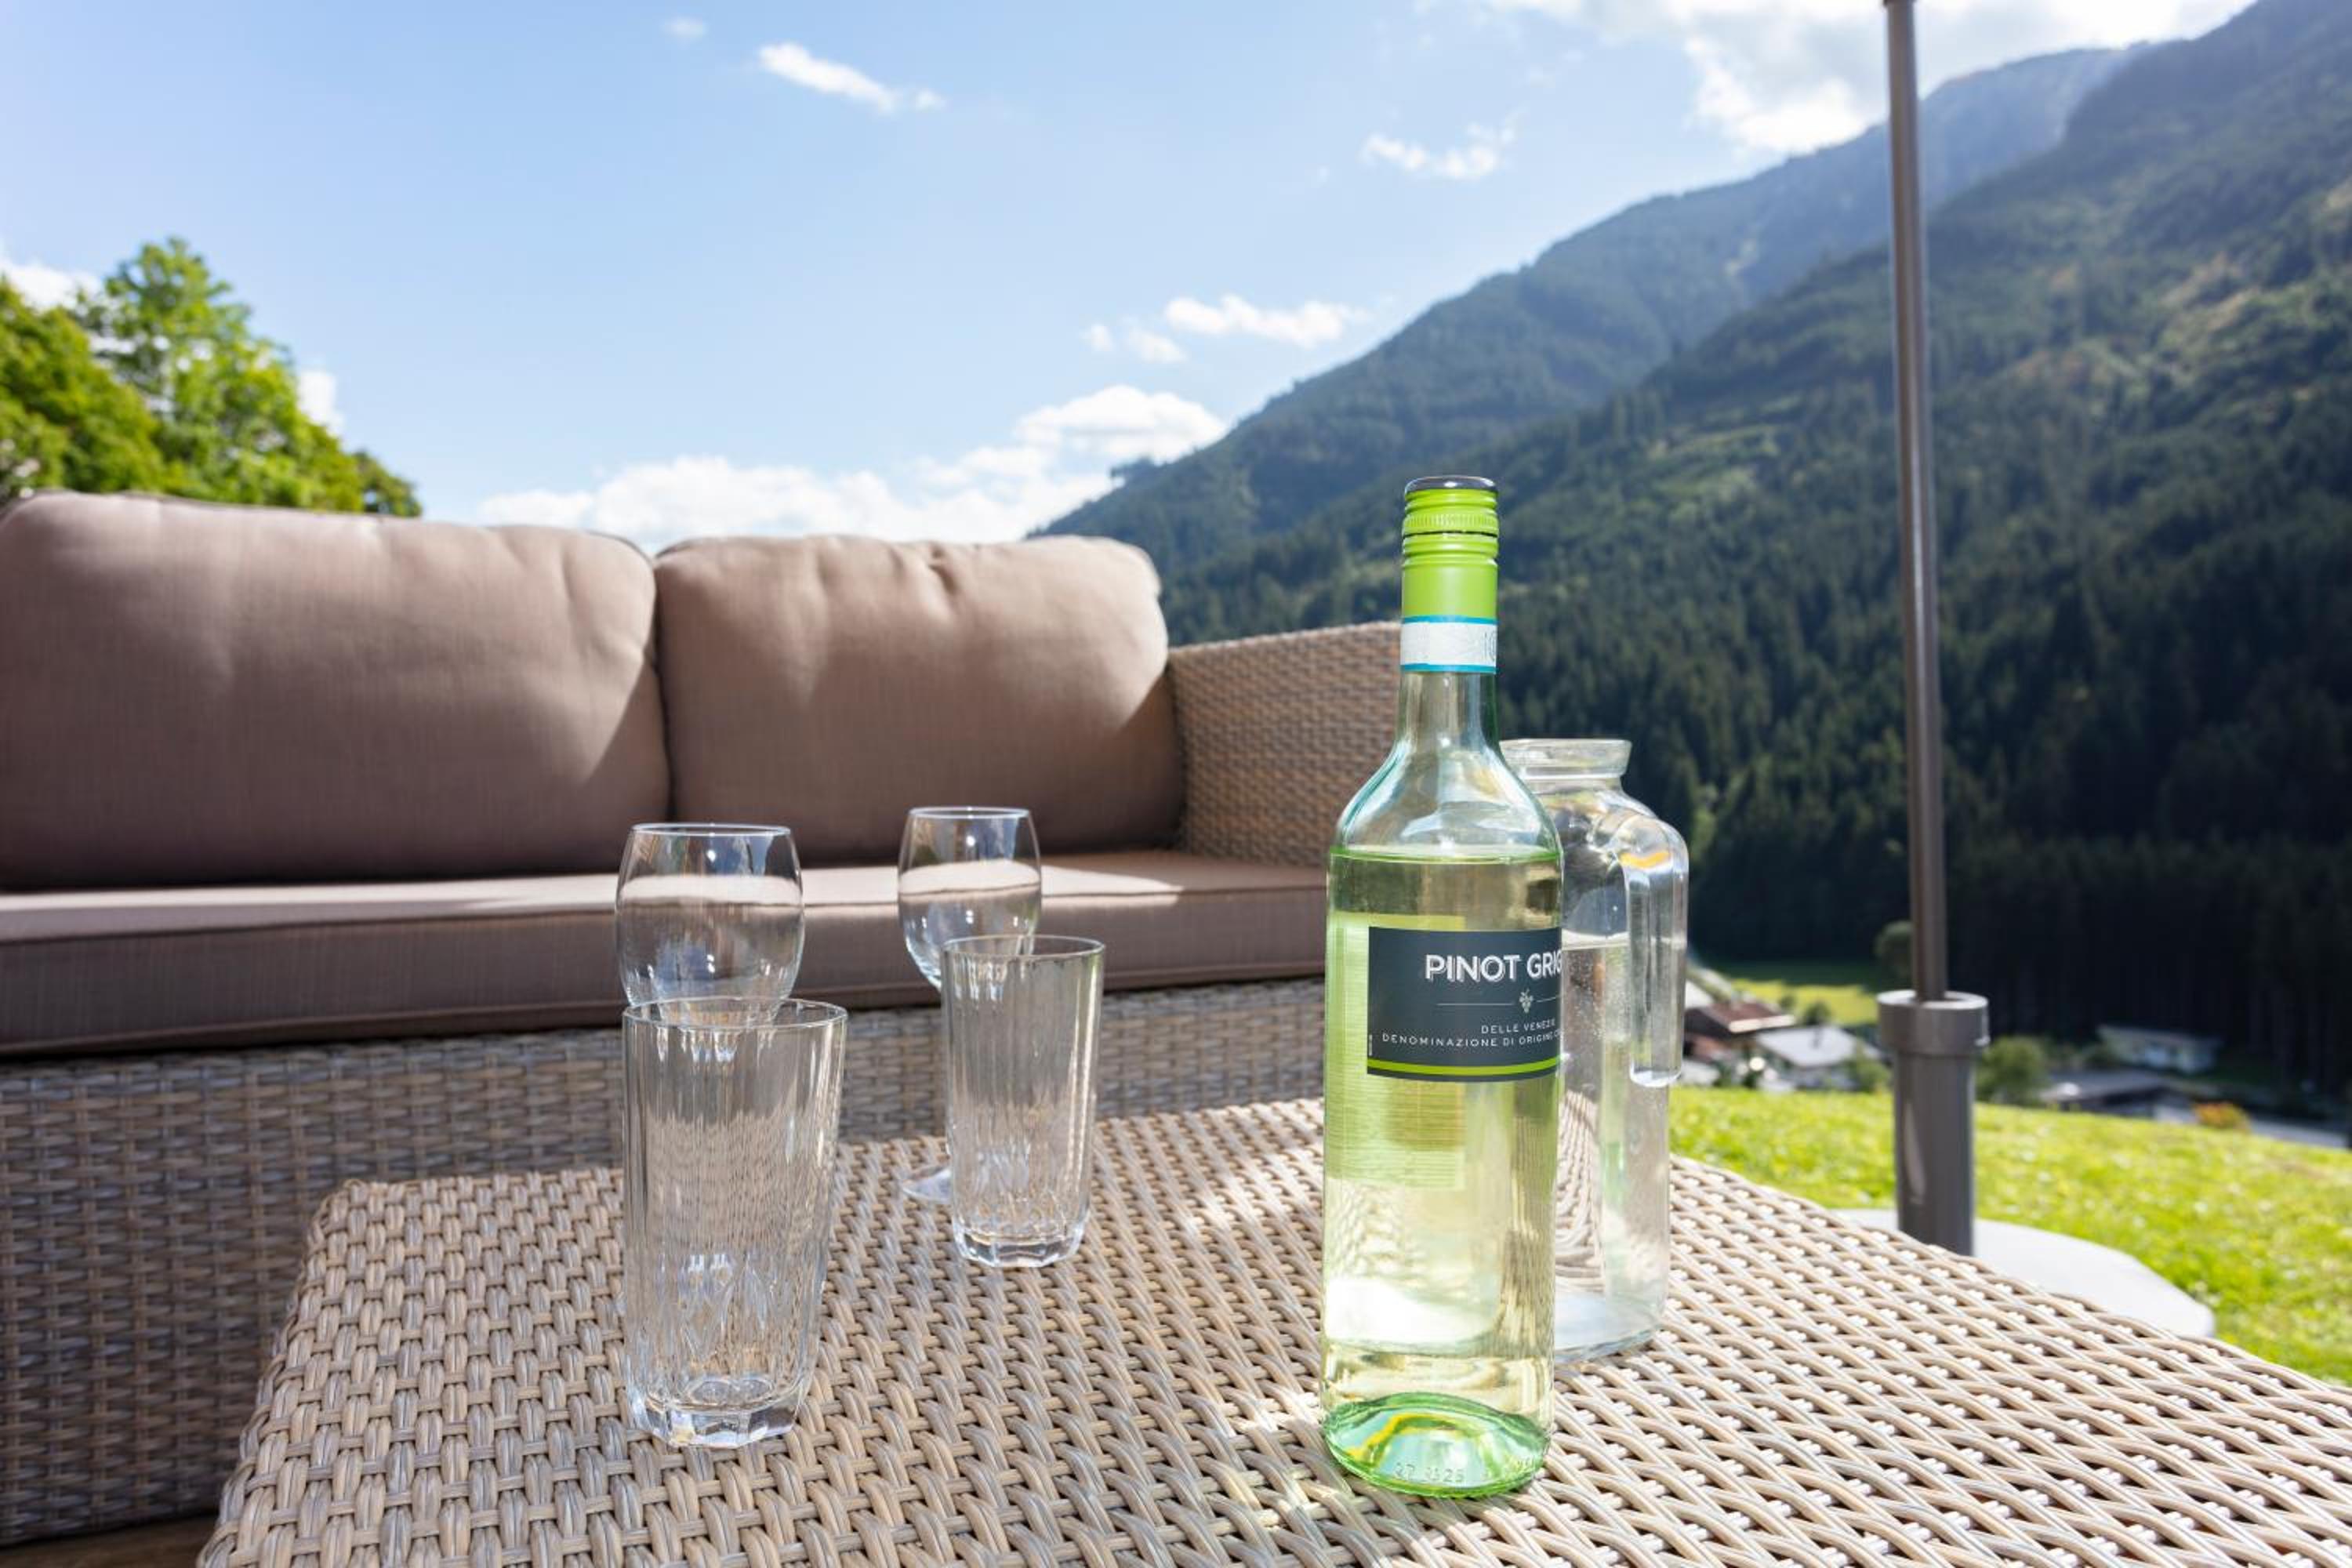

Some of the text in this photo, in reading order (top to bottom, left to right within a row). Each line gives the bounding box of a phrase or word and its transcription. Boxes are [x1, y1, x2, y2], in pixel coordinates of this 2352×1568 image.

[1425, 953, 1521, 982] PINOT
[1480, 1023, 1519, 1035] DELLE
[1382, 1033, 1498, 1047] DENOMINAZIONE
[1503, 1036, 1515, 1047] DI
